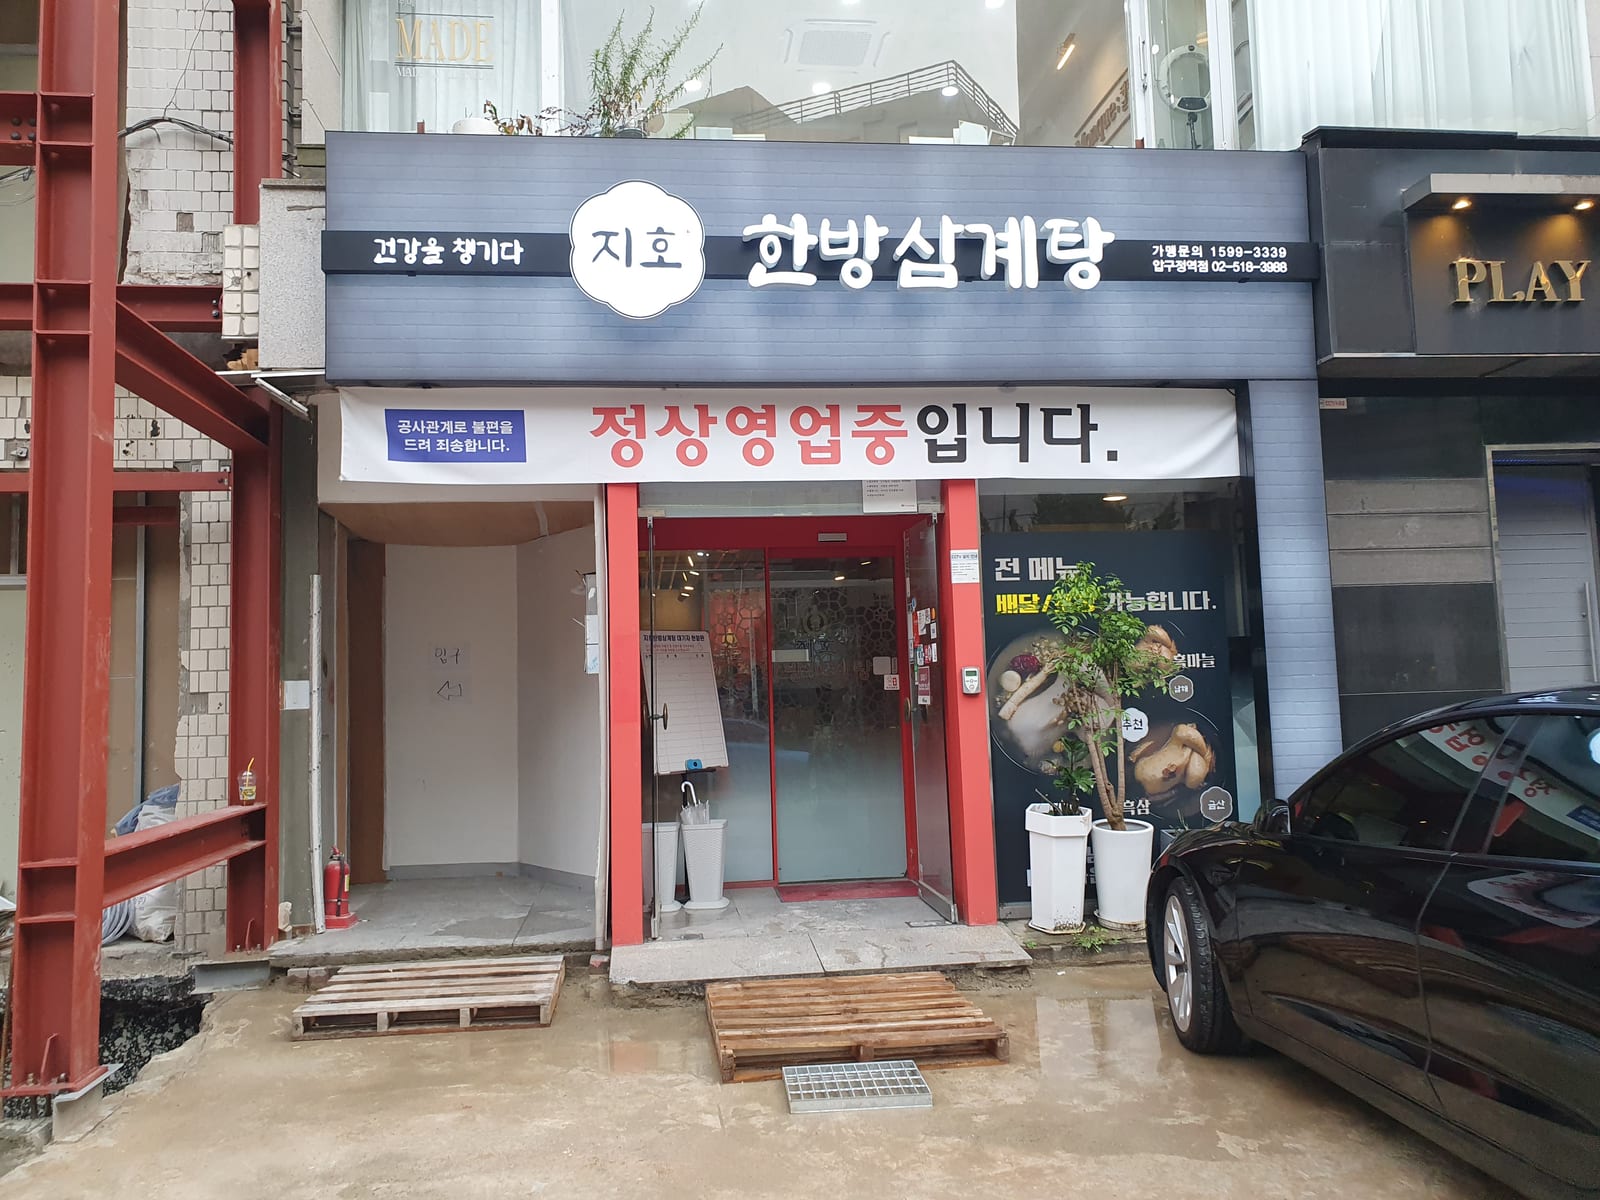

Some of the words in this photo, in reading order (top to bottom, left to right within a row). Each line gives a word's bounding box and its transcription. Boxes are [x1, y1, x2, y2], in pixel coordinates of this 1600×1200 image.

[396, 18, 494, 62] MADE
[373, 237, 445, 266] 건강을
[452, 237, 524, 266] 챙기다
[592, 226, 682, 269] 지호
[742, 213, 1115, 290] 한방삼계탕
[1152, 244, 1203, 258] 가맹문의
[1210, 246, 1287, 259] 1599-3339
[1152, 259, 1209, 273] 압구정역점
[1211, 261, 1288, 274] 02-518-3988
[1449, 258, 1592, 305] PLAY
[398, 419, 468, 434] 공사관계로
[472, 420, 513, 435] 불편을
[590, 402, 1118, 468] 정상영업중입니다.
[404, 438, 431, 452] 드려
[436, 438, 510, 453] 죄송합니다.
[994, 557, 1020, 582] 전
[1172, 652, 1216, 668] 흑마늘
[1122, 718, 1144, 731] 추천
[1123, 799, 1152, 816] 흑삼
[1207, 800, 1226, 811] 금산
